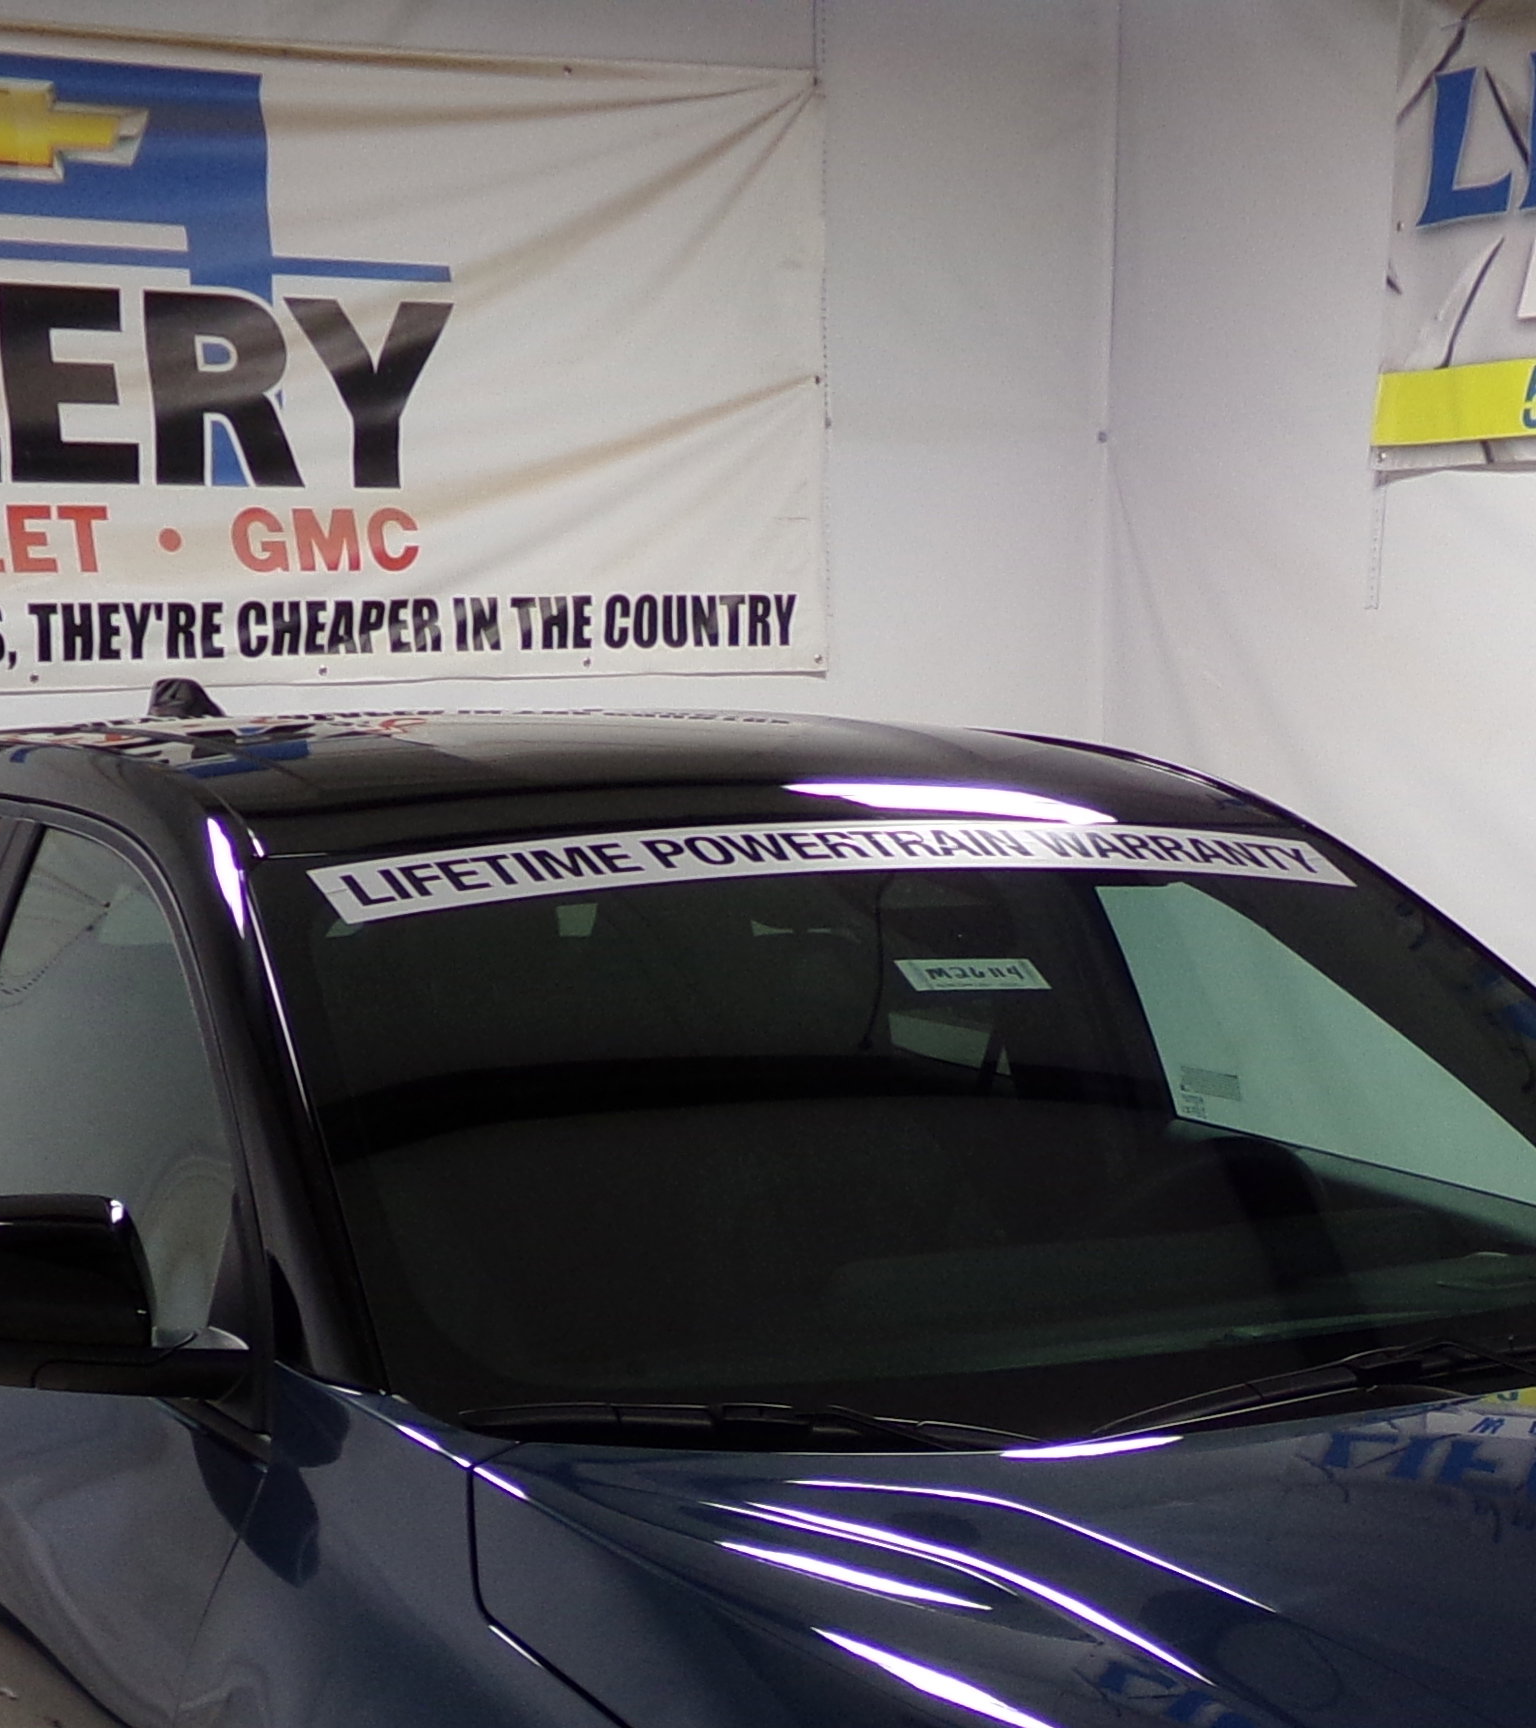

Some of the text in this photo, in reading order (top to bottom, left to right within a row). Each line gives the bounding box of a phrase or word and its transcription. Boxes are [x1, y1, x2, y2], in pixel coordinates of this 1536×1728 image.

[231, 506, 419, 573] GMC
[28, 600, 225, 664] THEY'RE
[237, 598, 443, 658] CHEAPER
[452, 596, 502, 652] IN
[510, 594, 594, 652] THE
[603, 593, 798, 651] COUNTRY
[339, 829, 1319, 908] LIFETIME POWERTRAIN WARRANTY
